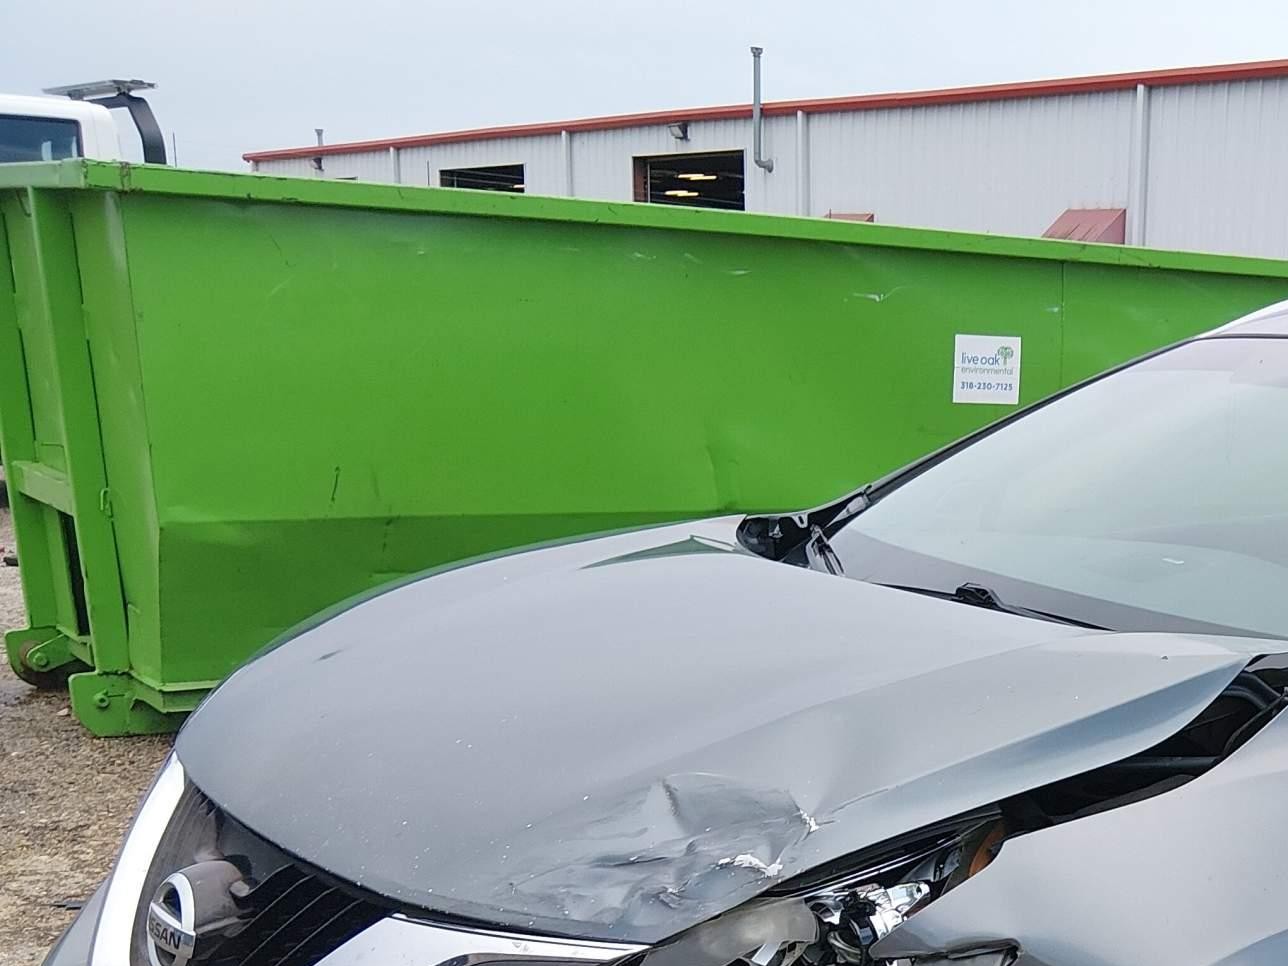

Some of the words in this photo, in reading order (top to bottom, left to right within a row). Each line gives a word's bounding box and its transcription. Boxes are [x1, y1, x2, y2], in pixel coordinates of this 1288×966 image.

[961, 352, 979, 365] live
[980, 353, 1000, 366] oak
[961, 367, 1013, 375] environmental
